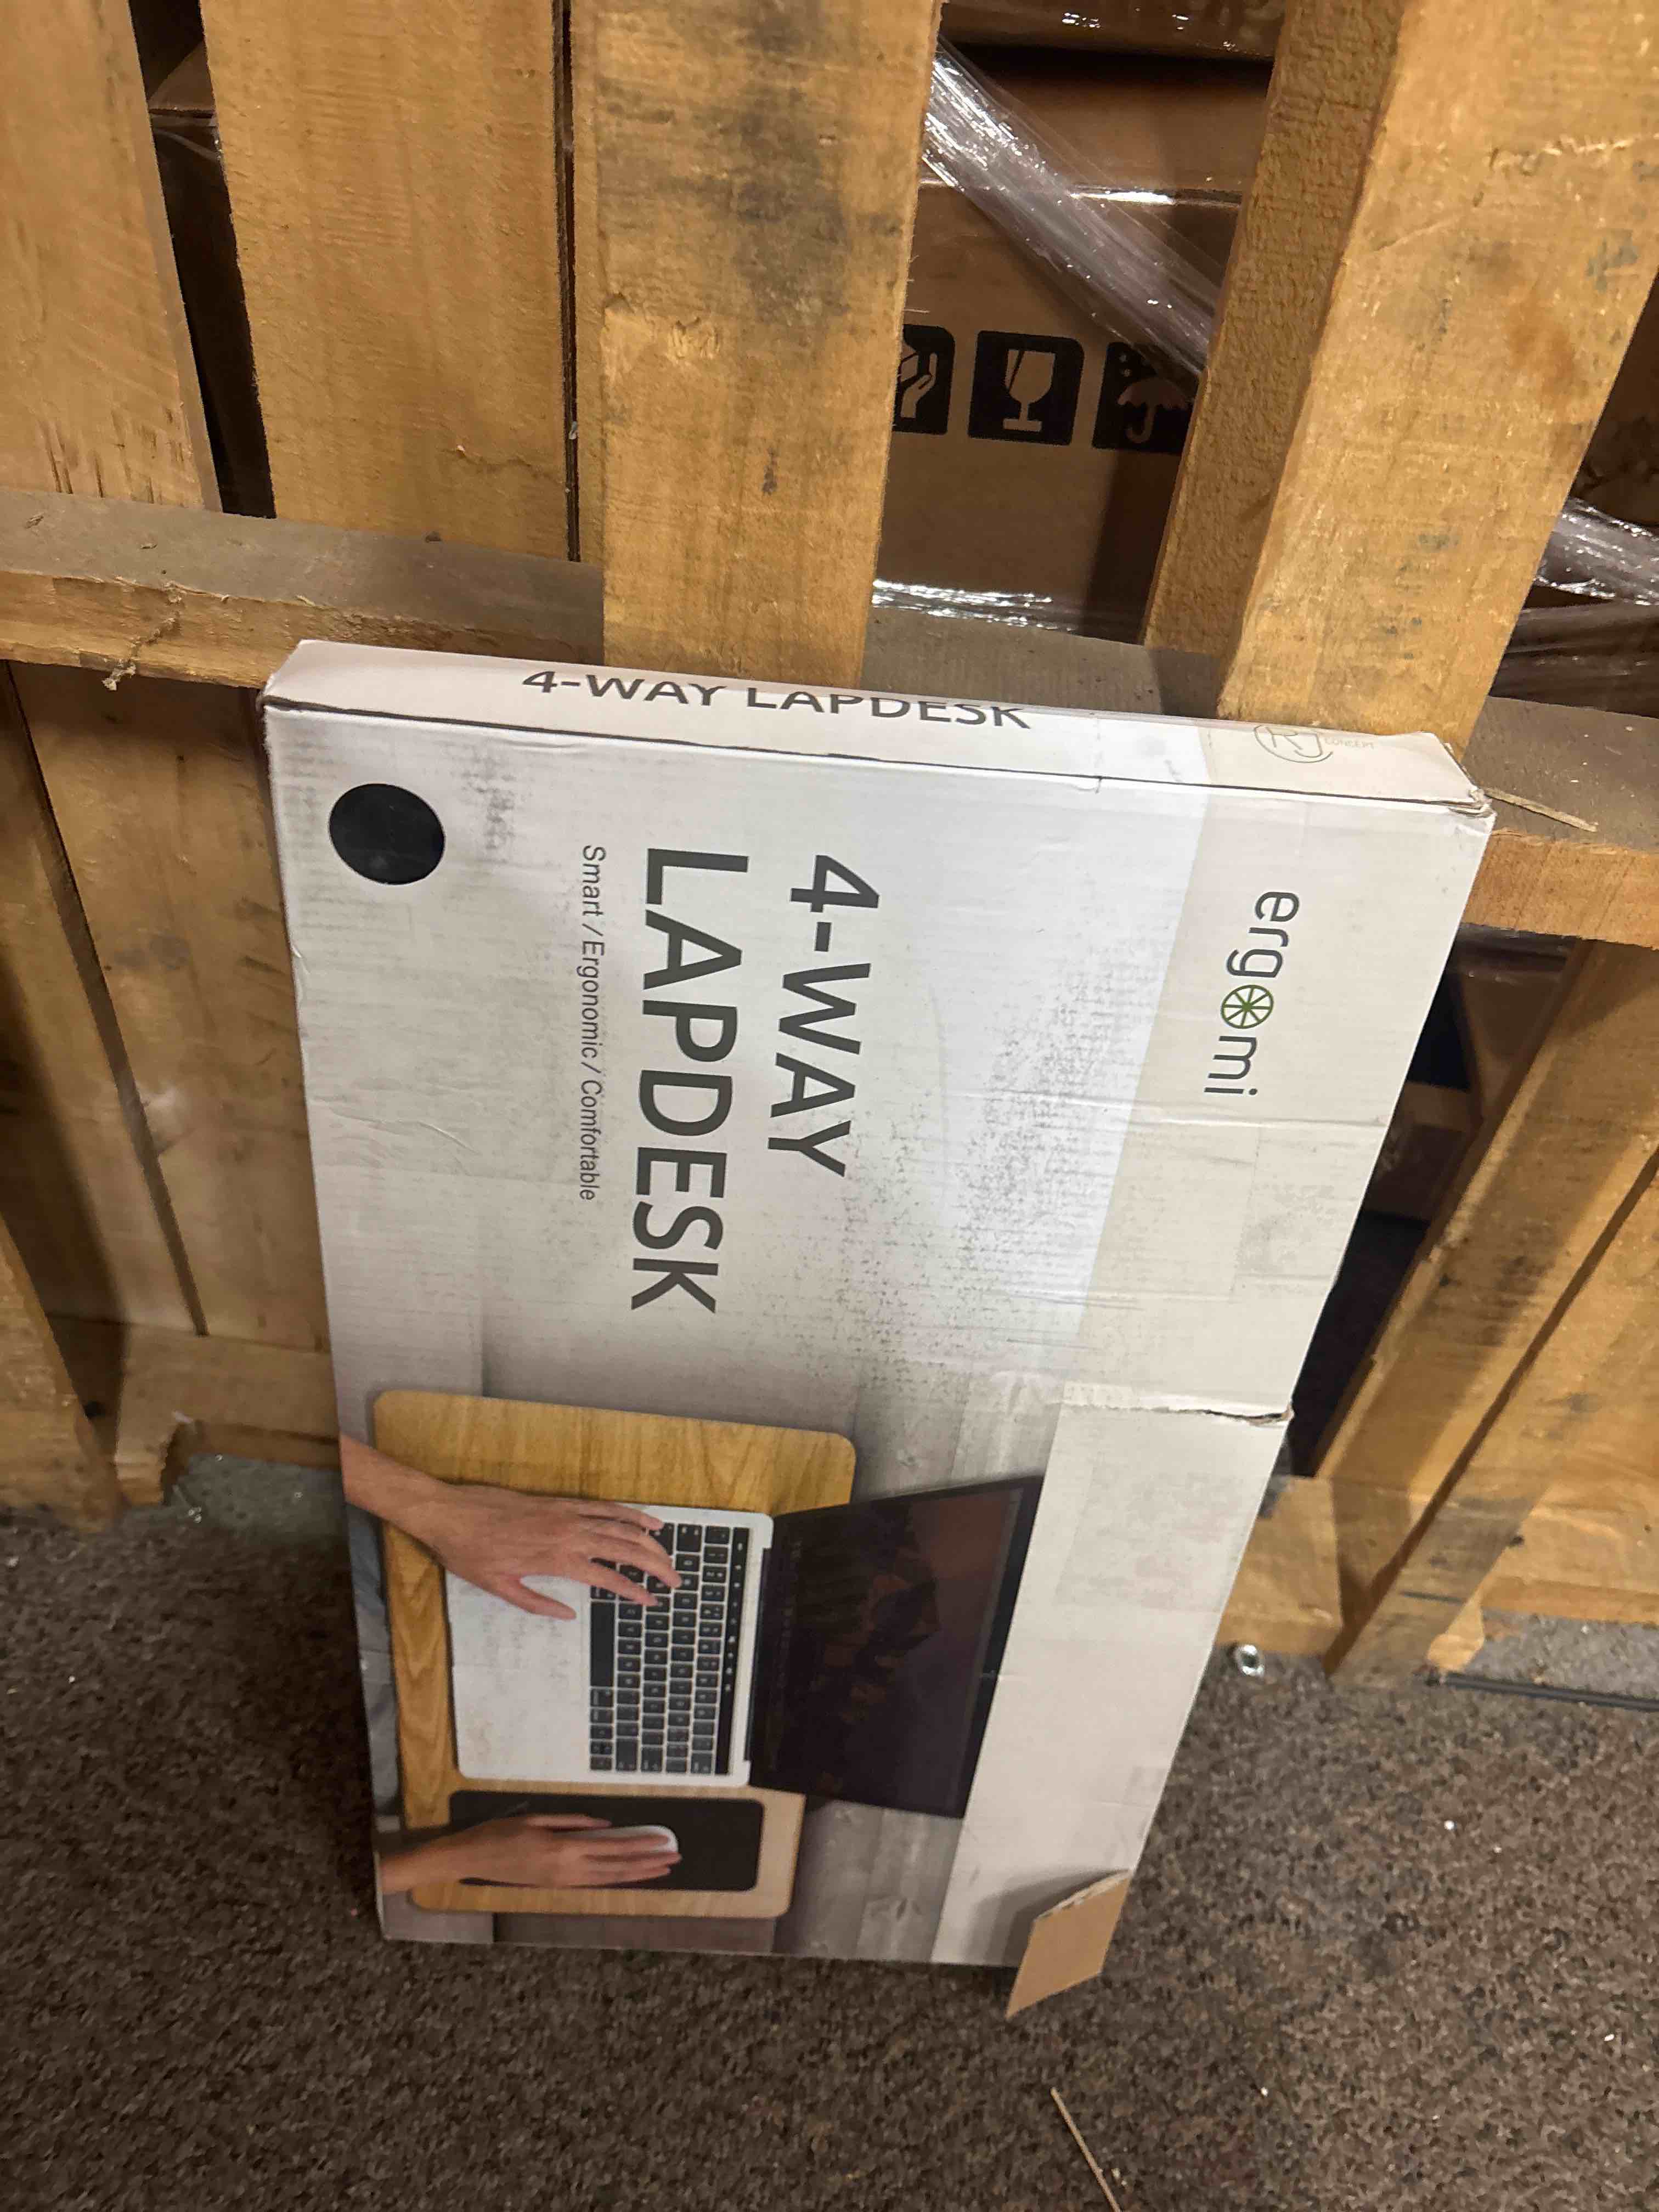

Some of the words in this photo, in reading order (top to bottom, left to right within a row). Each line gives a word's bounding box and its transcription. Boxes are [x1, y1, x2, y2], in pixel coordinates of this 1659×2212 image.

[522, 670, 726, 707] 4-WAY
[747, 687, 1030, 729] LAPDESK
[582, 844, 606, 917] Smart
[576, 940, 605, 1059] Ergonomic
[768, 854, 879, 1178] 4-WAY
[1203, 891, 1300, 1096] ergomi
[579, 1079, 603, 1201] Comfortable
[631, 848, 749, 1314] LAPDESK
